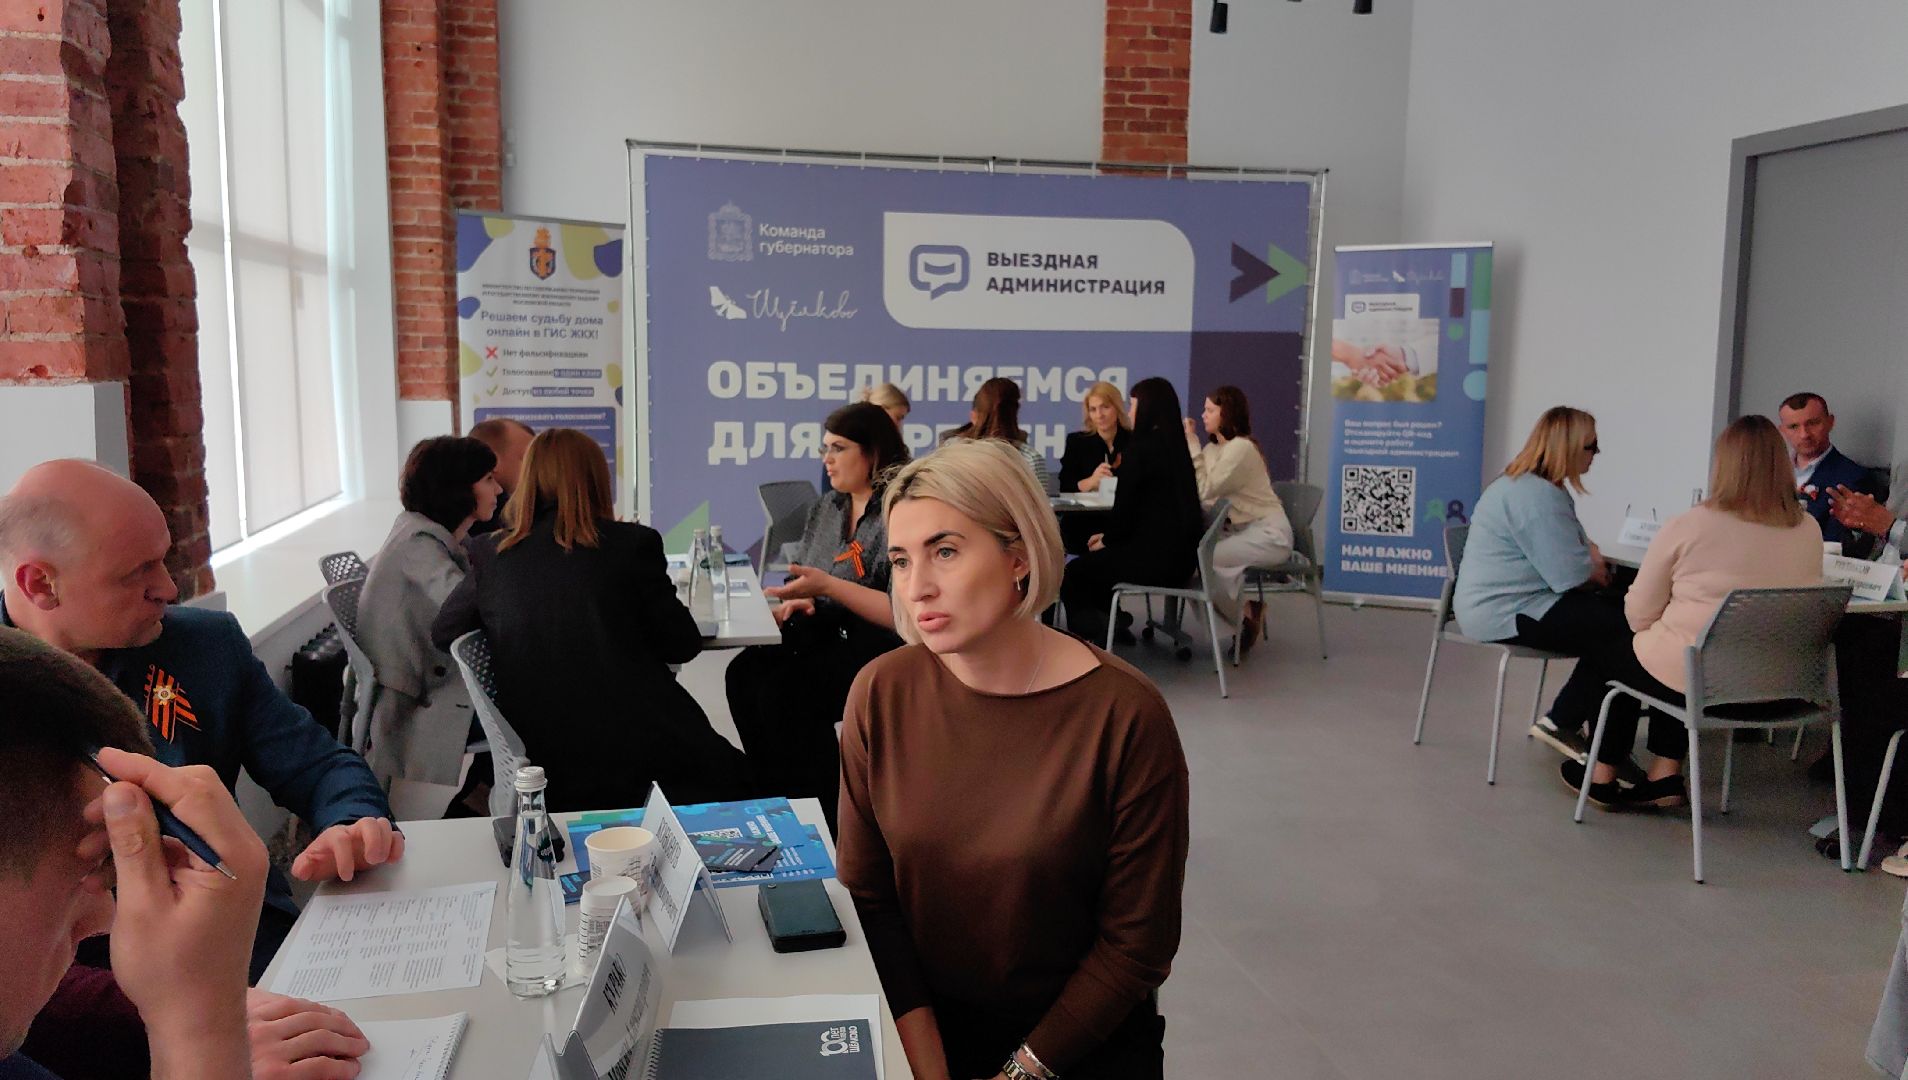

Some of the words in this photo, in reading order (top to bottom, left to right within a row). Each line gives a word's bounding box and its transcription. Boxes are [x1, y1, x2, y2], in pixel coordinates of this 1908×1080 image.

[759, 224, 826, 240] Команда
[759, 240, 854, 258] губернатора
[987, 252, 1098, 271] ВЫЕЗДНАЯ
[986, 277, 1165, 296] АДМИНИСТРАЦИЯ
[481, 311, 527, 322] Решаем
[531, 314, 571, 326] судьбу
[574, 317, 603, 325] дома
[486, 328, 529, 337] онлайн
[544, 329, 567, 338] ГИС
[570, 329, 599, 339] ЖКХ!
[708, 422, 821, 465] ДЛЯ
[1341, 545, 1373, 557] НАМ
[1376, 547, 1432, 560] ВАЖНО
[1341, 560, 1383, 574] ВАШЕ
[1386, 563, 1448, 577] МНЕНИЕ
